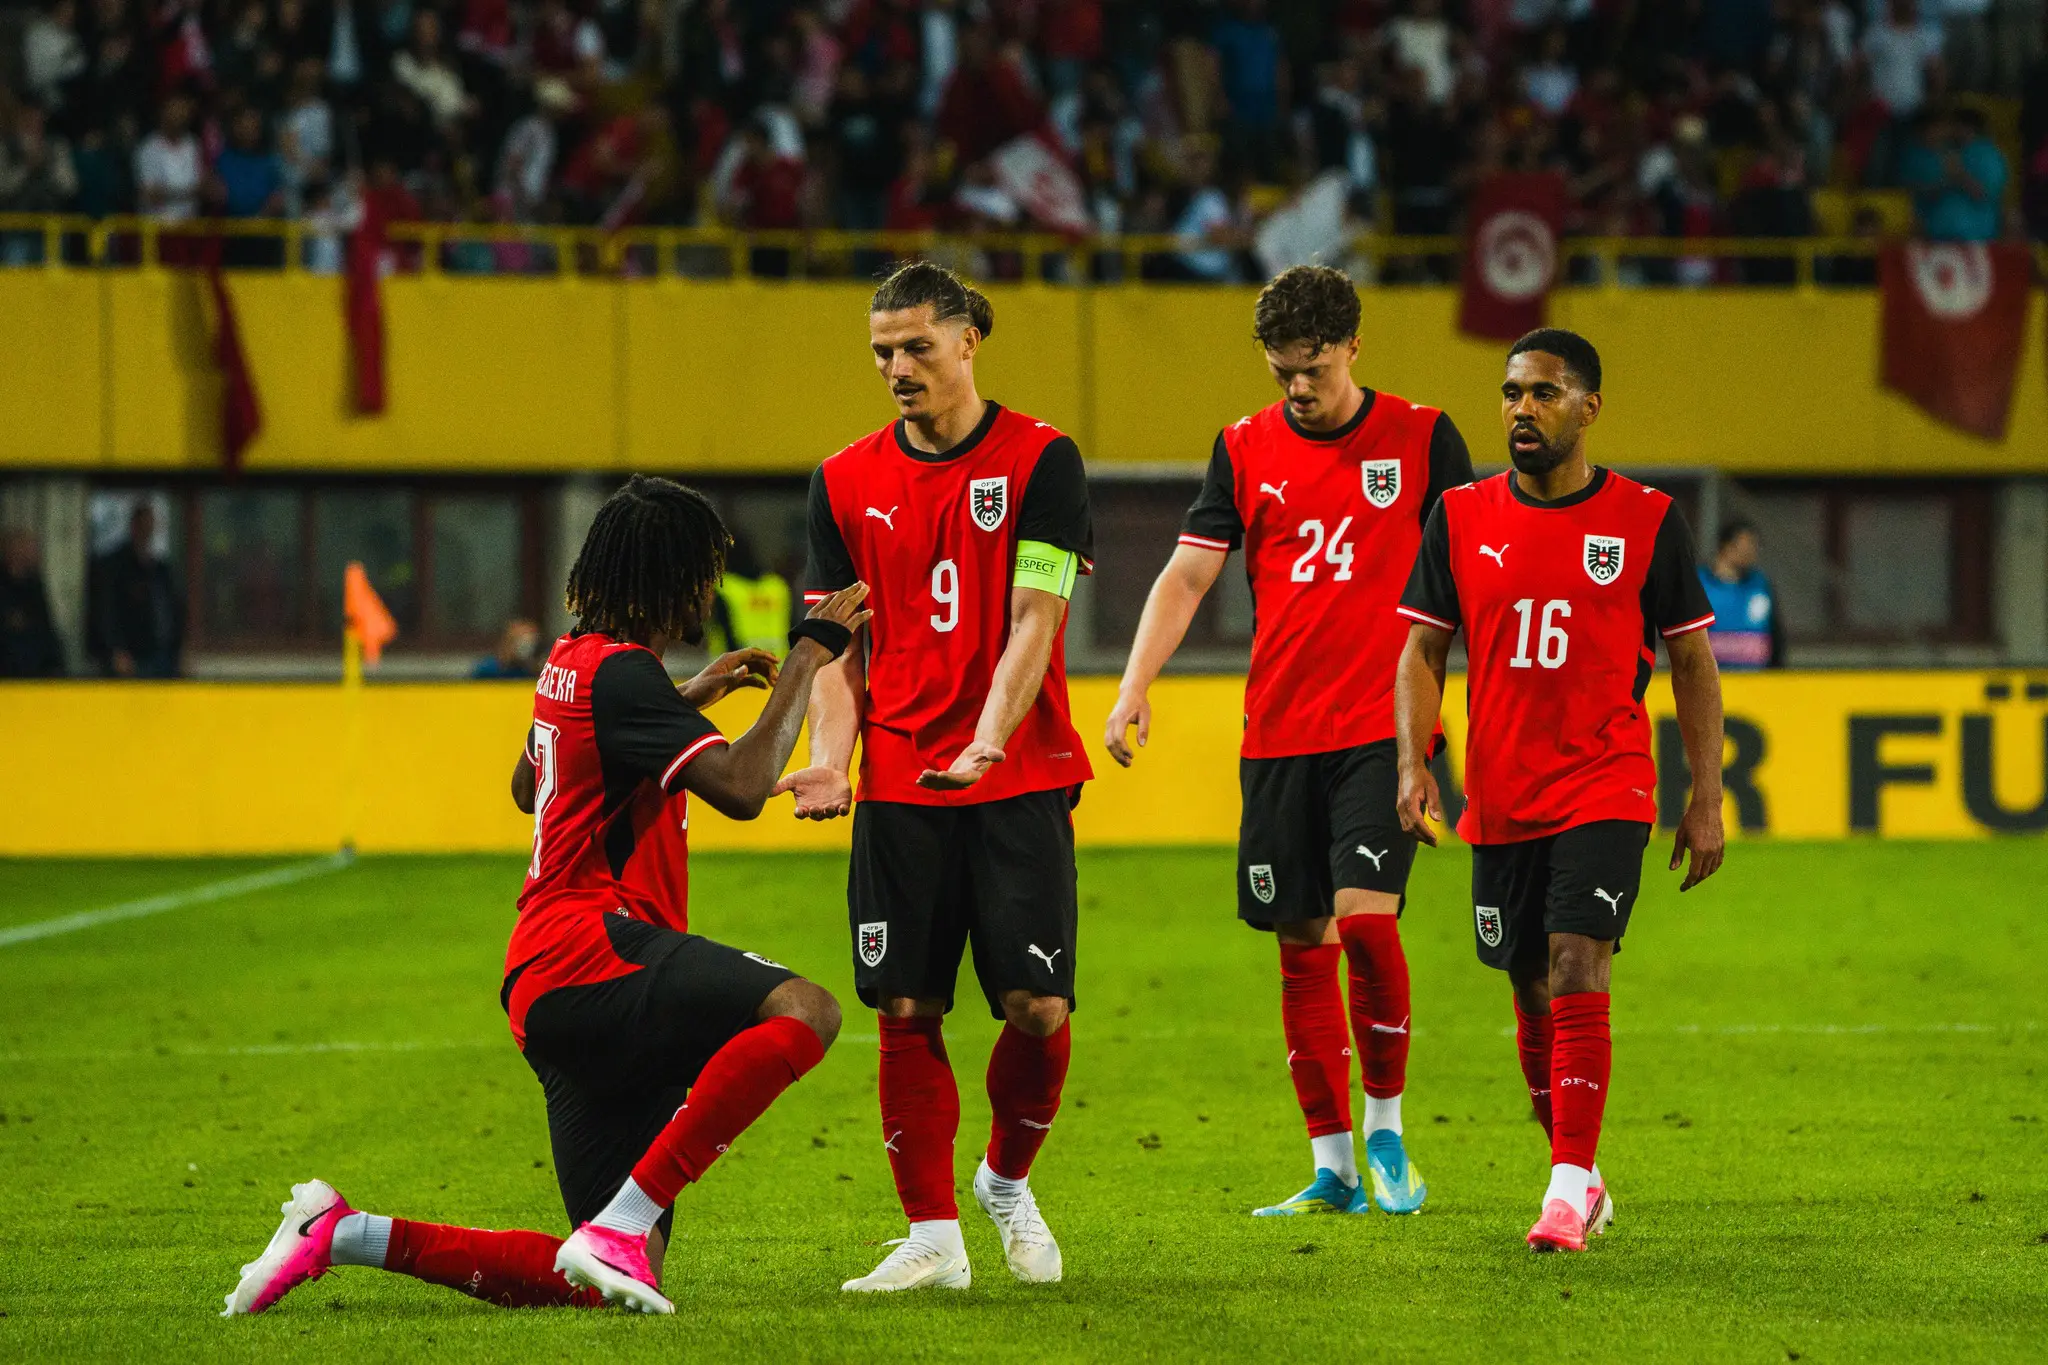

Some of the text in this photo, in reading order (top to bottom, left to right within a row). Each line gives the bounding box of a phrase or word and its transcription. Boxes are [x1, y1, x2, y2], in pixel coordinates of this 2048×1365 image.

[1290, 516, 1355, 583] 24
[930, 558, 959, 633] 9
[1509, 598, 1572, 669] 16
